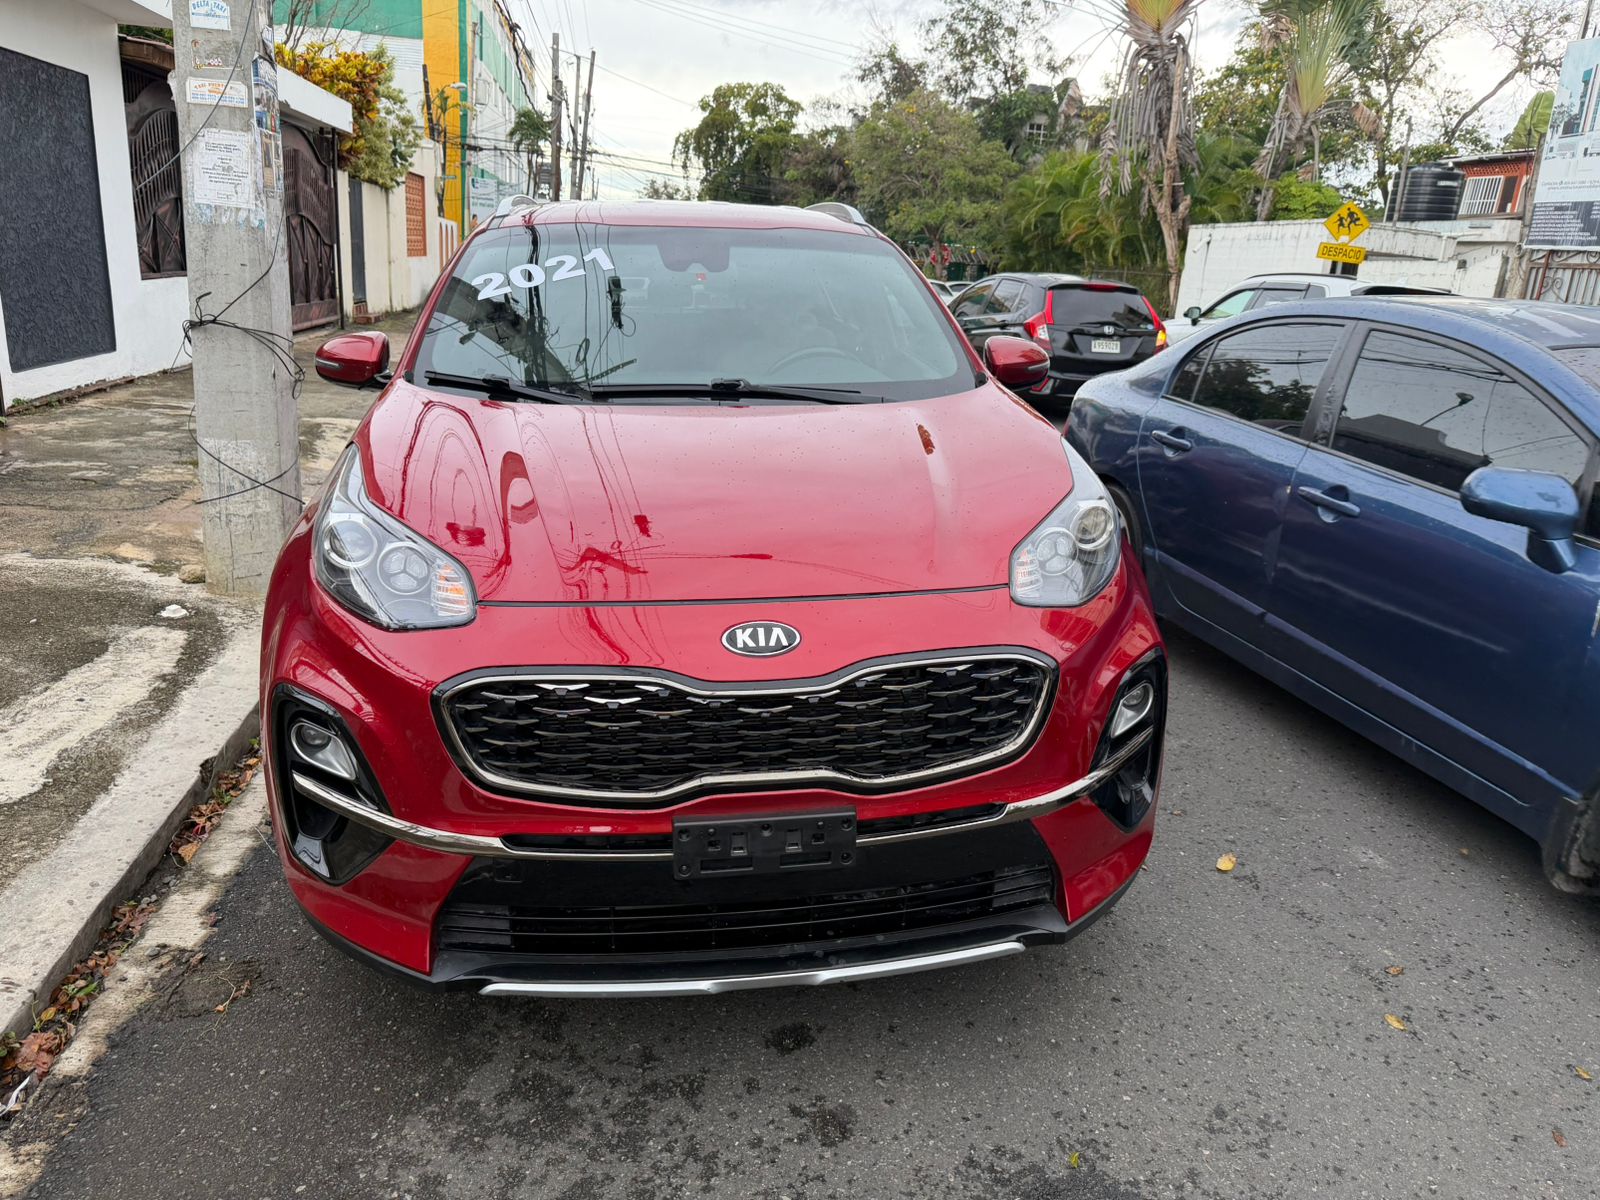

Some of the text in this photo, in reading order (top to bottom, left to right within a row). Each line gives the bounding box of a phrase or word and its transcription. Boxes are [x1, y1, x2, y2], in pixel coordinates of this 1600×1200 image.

[192, 0, 227, 13] DELTA TAXI
[1321, 245, 1362, 260] DESPACIO
[471, 248, 615, 300] 2021
[735, 627, 788, 648] KIA
